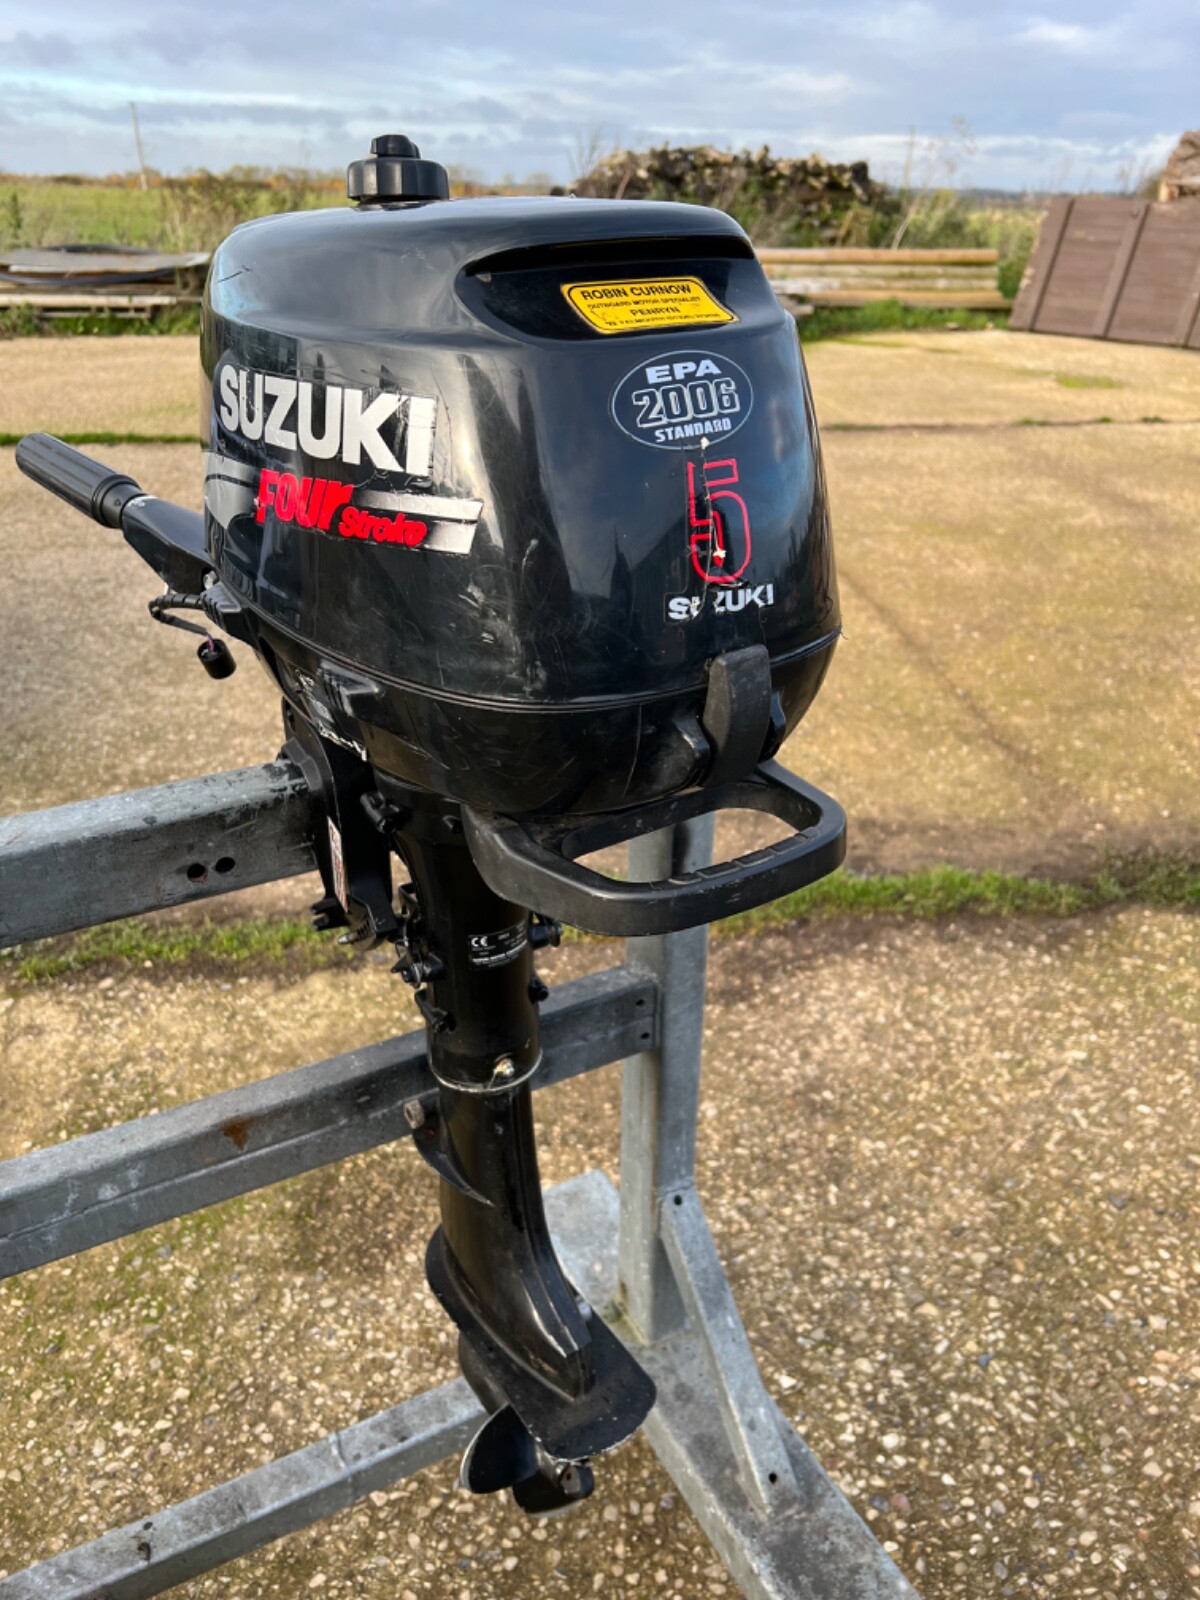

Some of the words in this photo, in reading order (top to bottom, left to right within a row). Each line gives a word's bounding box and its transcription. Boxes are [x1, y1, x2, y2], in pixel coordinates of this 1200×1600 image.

[580, 286, 628, 300] ROBIN
[630, 284, 692, 296] CURNOW
[630, 306, 680, 316] PENRYN
[645, 359, 721, 384] EPA
[632, 377, 740, 428] 2006
[219, 364, 435, 478] SUZUKI
[654, 417, 732, 442] STANDARD
[338, 506, 427, 547] Stroke
[687, 458, 751, 583] 5
